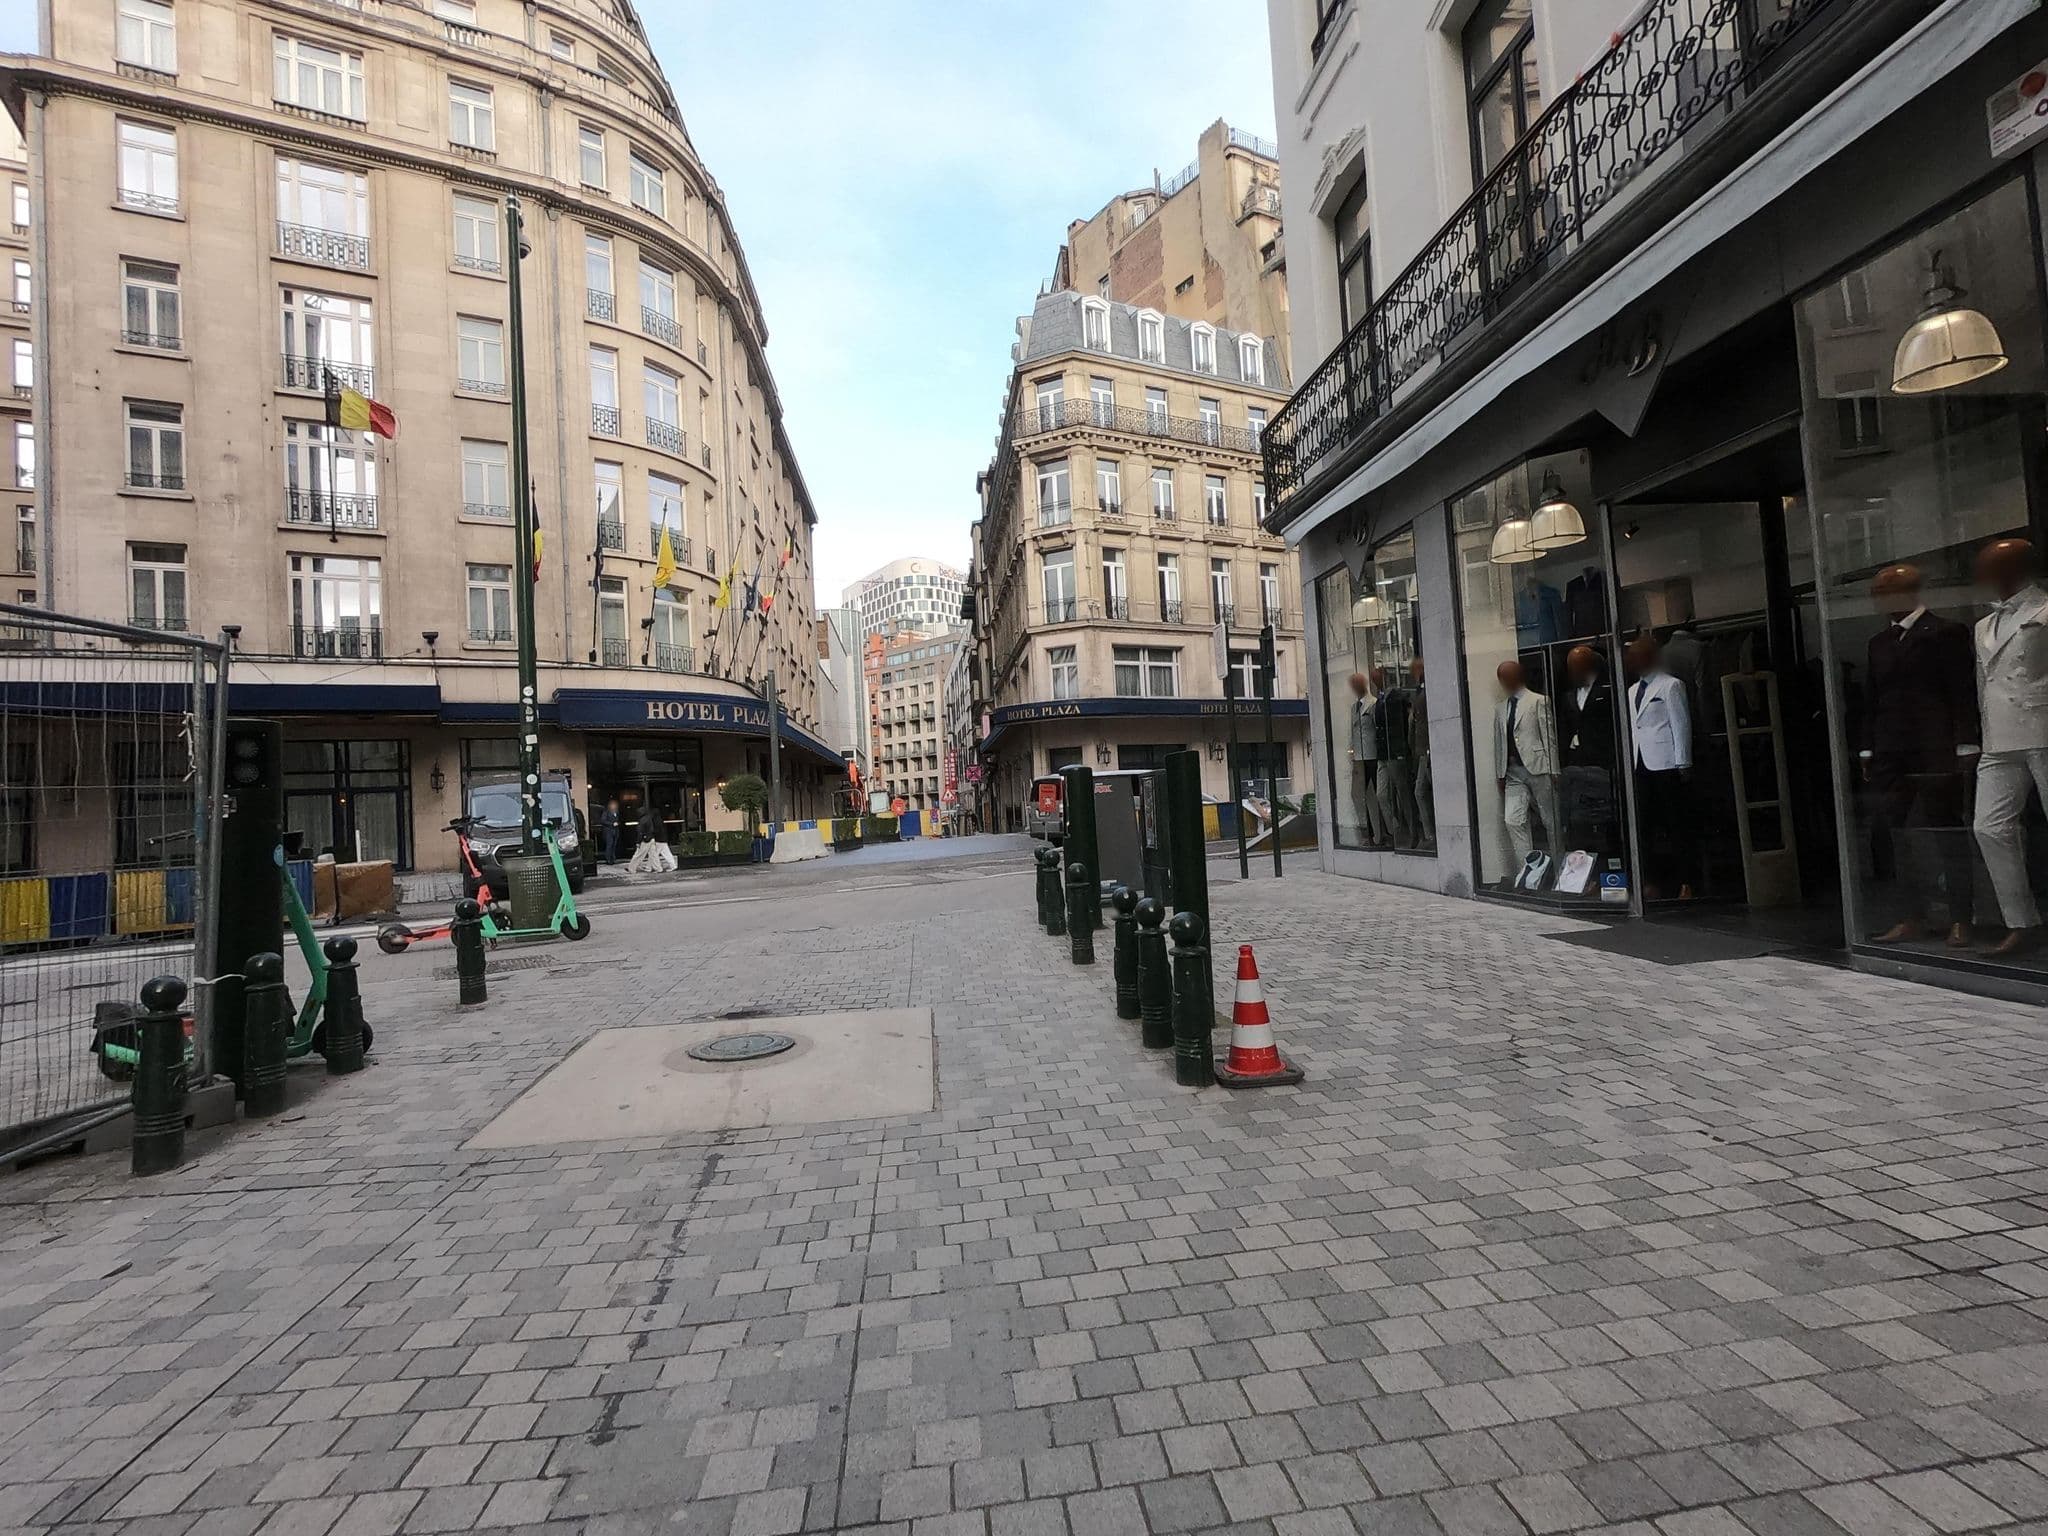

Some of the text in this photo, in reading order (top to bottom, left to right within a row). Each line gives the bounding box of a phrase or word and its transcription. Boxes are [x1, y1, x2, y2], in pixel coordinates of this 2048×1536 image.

[647, 702, 769, 726] HOTEL PLAZ
[1007, 705, 1080, 720] HOTEL PLAZA
[1233, 703, 1262, 713] PLAZA
